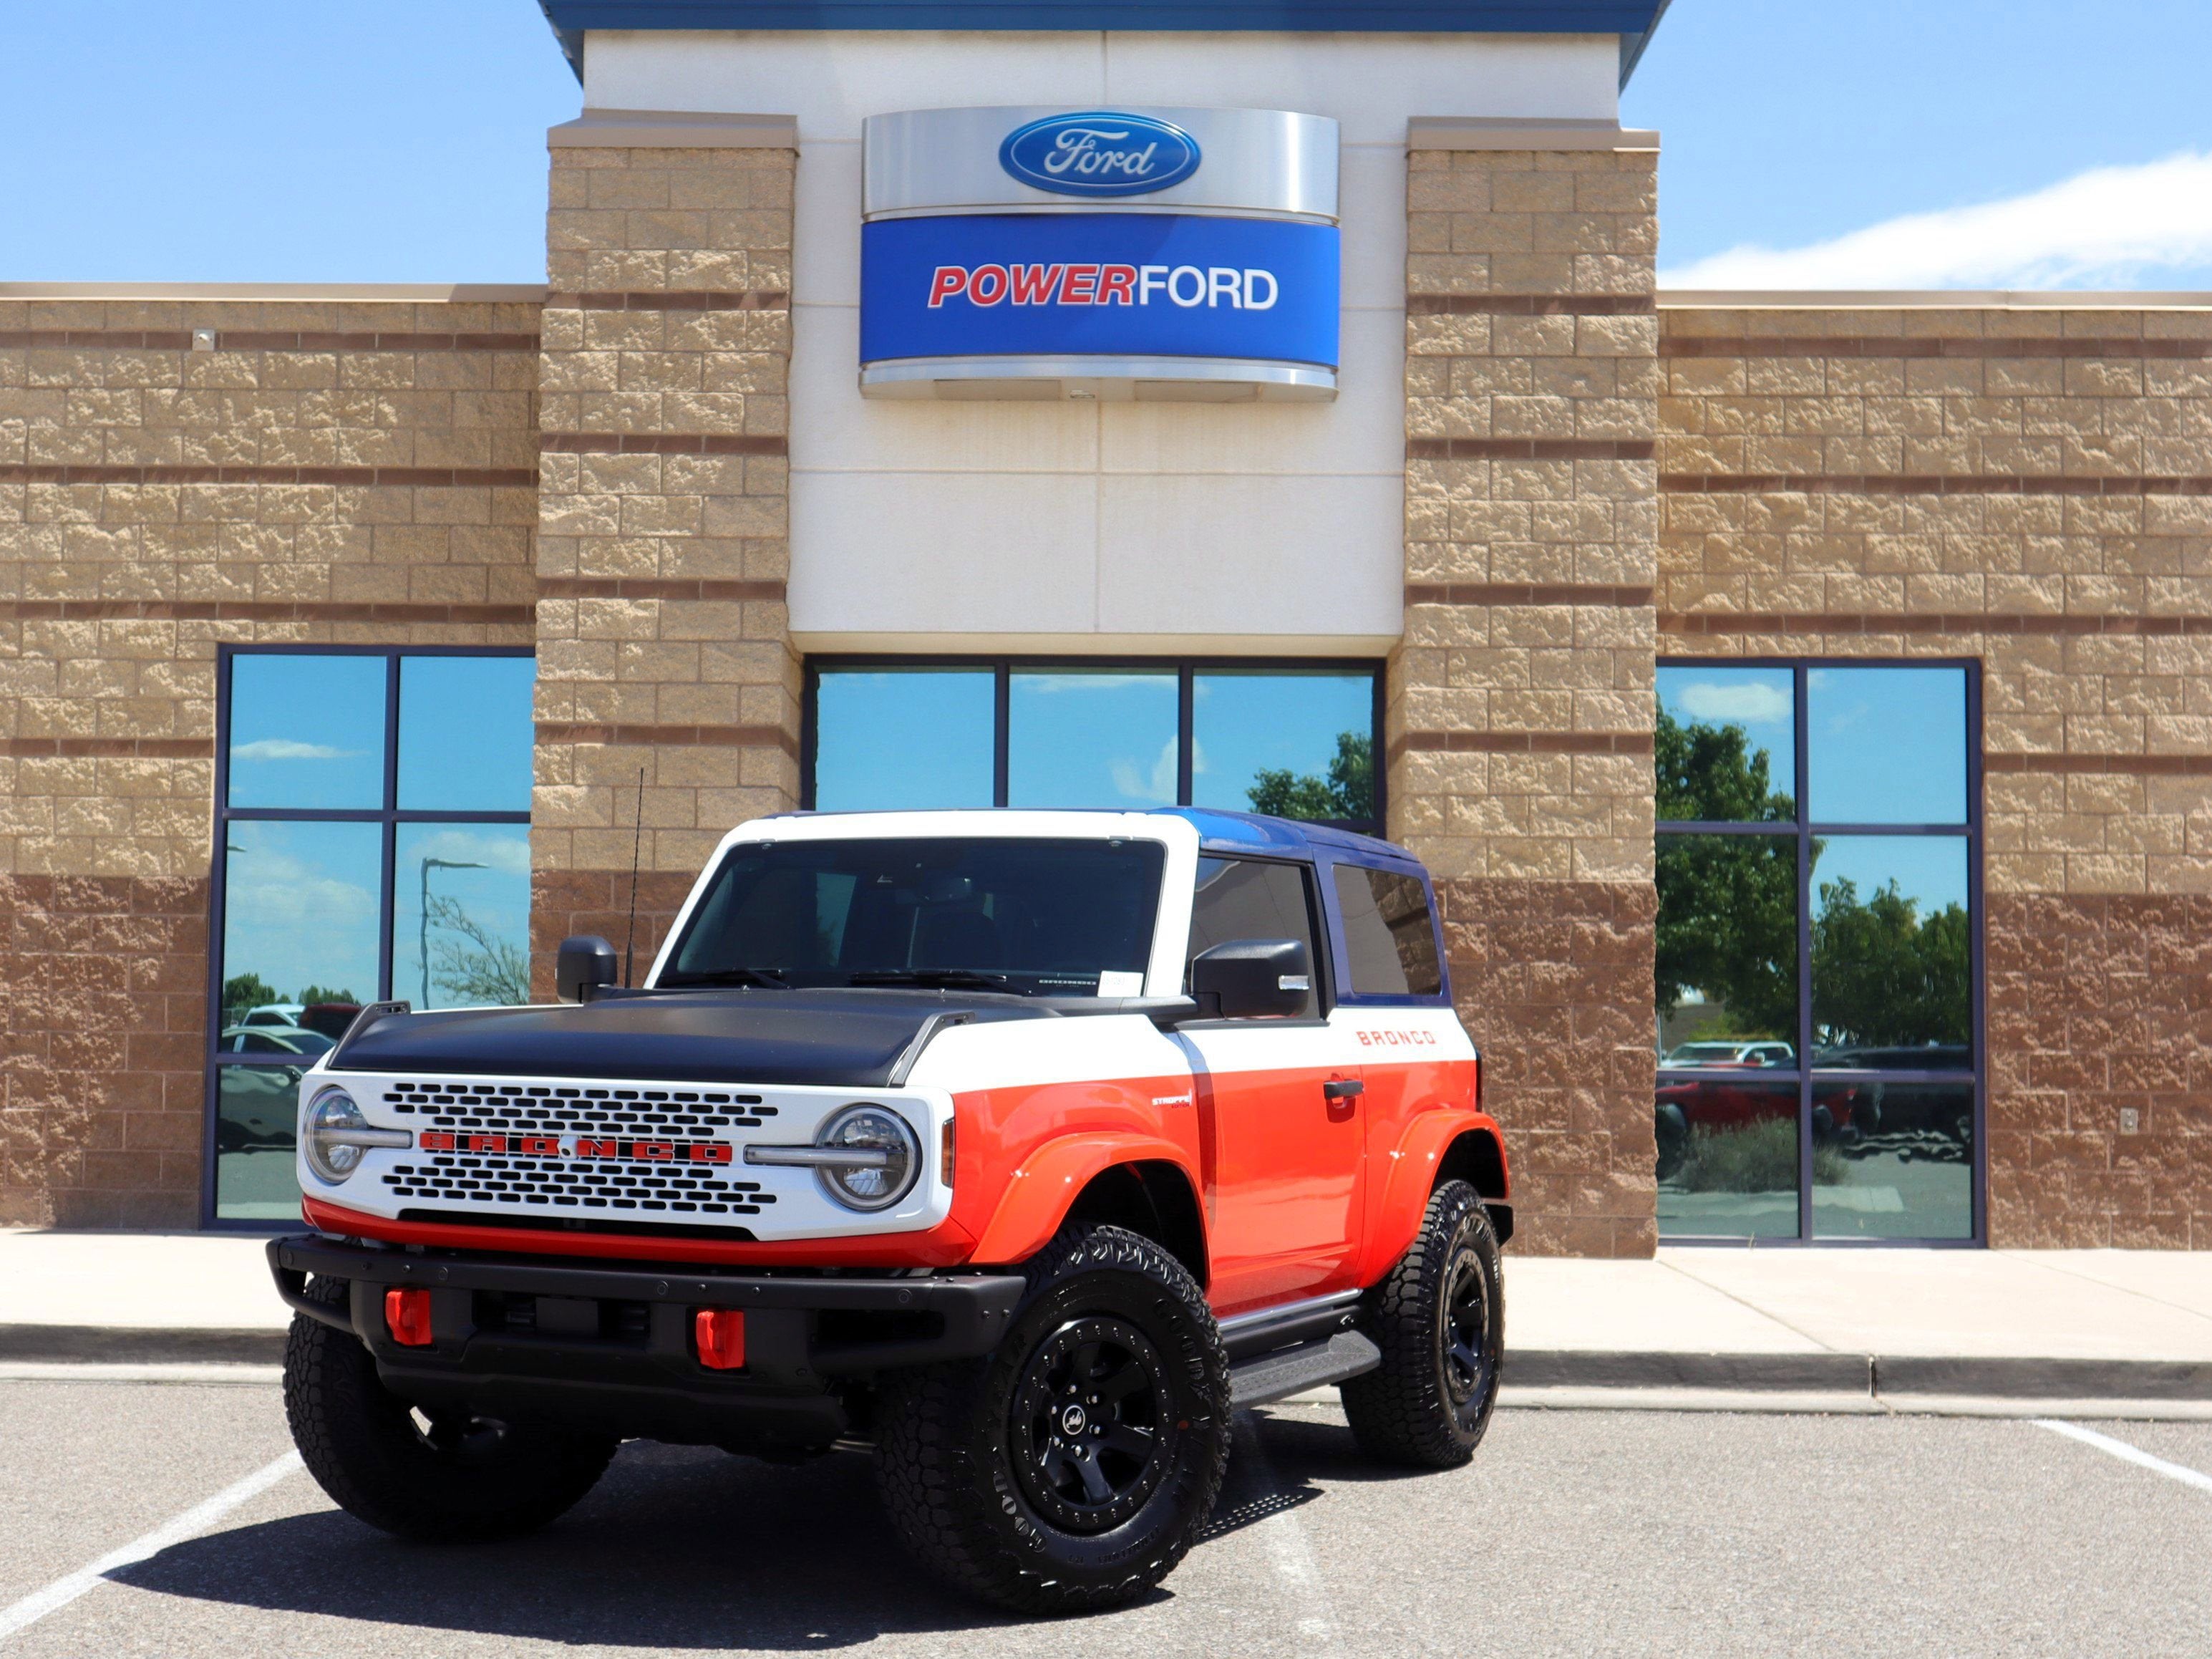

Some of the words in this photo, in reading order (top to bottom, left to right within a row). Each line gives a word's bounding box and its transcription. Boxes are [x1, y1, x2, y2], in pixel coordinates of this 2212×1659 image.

[1044, 127, 1155, 175] Ford
[1356, 1030, 1436, 1045] BRONCO
[419, 1131, 733, 1163] BRONCO
